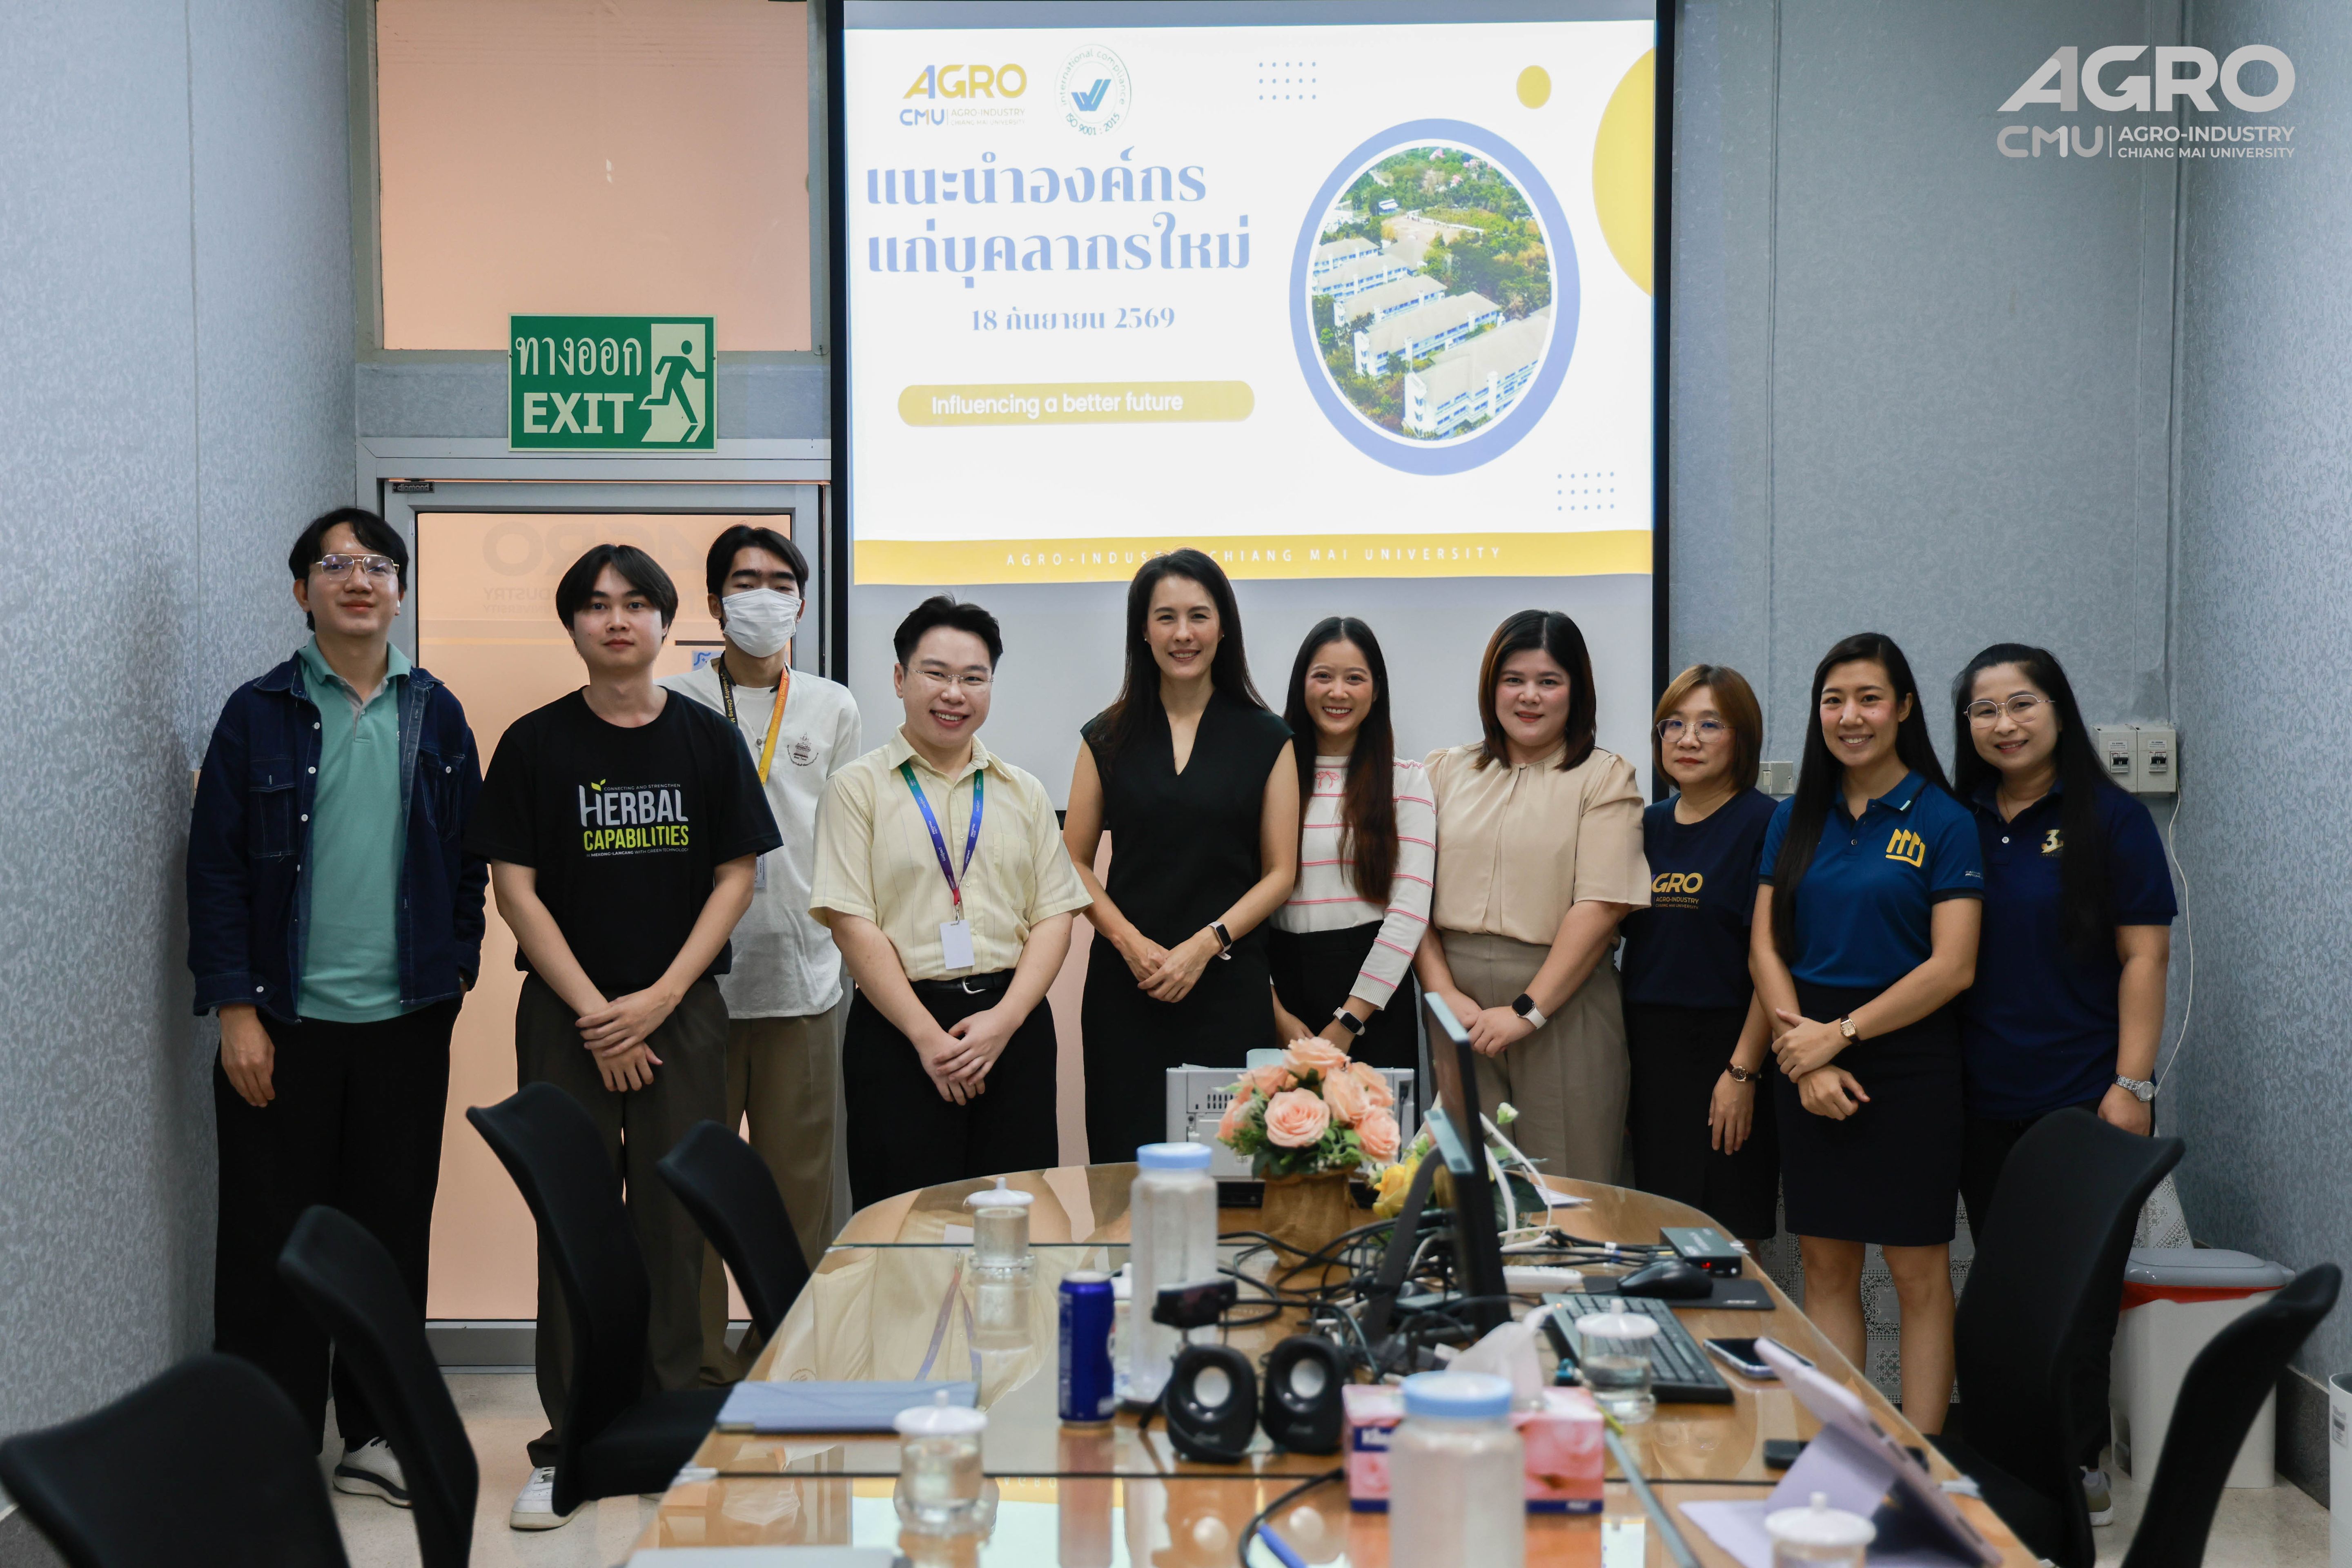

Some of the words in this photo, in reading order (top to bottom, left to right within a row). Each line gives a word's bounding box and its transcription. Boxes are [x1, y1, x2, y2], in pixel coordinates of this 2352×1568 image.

[902, 63, 1027, 99] AGRO
[1097, 51, 1126, 105] compliance
[900, 109, 944, 126] CMU
[951, 108, 1025, 117] AGRO-INDUSTRY
[1065, 112, 1078, 128] ISO
[1078, 124, 1097, 136] 9001
[1104, 112, 1120, 132] 2015
[866, 145, 1206, 205] แนะนำองค์กร
[868, 212, 1250, 289] แก่บุคลากรใหม่
[972, 310, 998, 331] 18
[1006, 306, 1106, 330] กันยายน
[1114, 307, 1175, 328] 2569
[515, 337, 642, 376] ทางออก
[523, 392, 634, 434] EXIT
[932, 393, 1040, 419] Influencing
[1045, 399, 1058, 413] a
[1063, 394, 1120, 413] better
[1125, 392, 1184, 412] future
[397, 483, 430, 491] diamond
[1310, 549, 1347, 561] MAI
[1365, 547, 1500, 561] UNIVERSITY
[579, 785, 688, 827] HERBAL
[584, 825, 689, 851] CAPABILITIES
[1652, 873, 1703, 893] GRO
